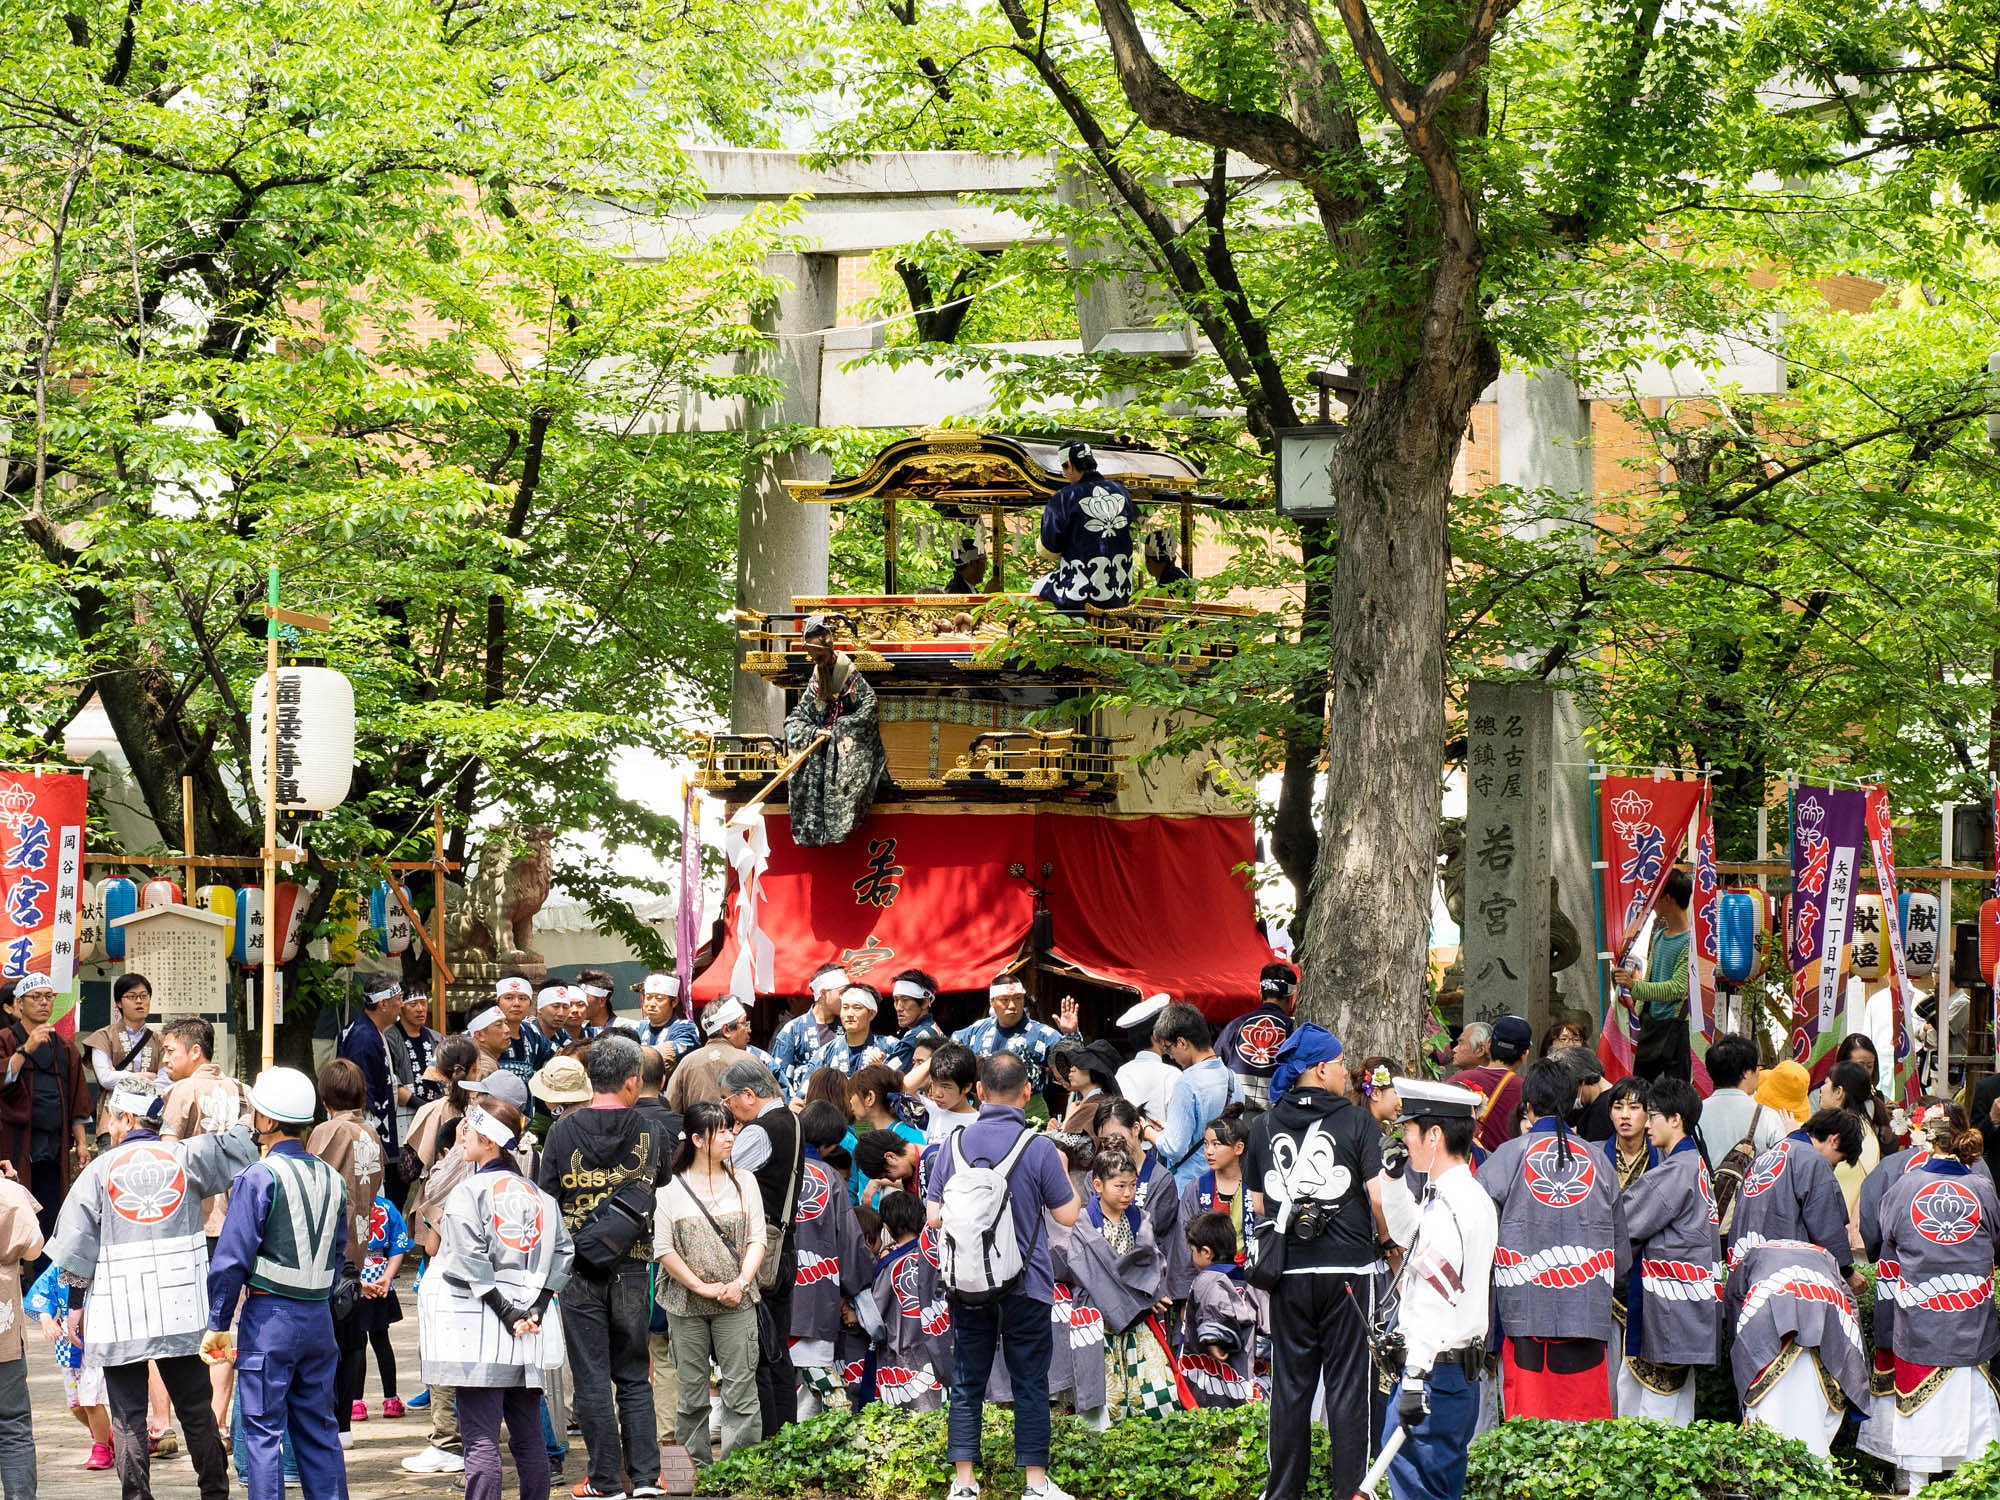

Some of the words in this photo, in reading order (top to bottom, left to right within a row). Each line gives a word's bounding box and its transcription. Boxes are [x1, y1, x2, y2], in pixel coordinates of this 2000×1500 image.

[1472, 715, 1497, 798] 總鎮守
[1501, 715, 1525, 799] 名古屋
[1821, 860, 1849, 1016] 矢場町一丁目町内会
[1852, 905, 1880, 968] 献燈
[1906, 904, 1937, 966] 献燈
